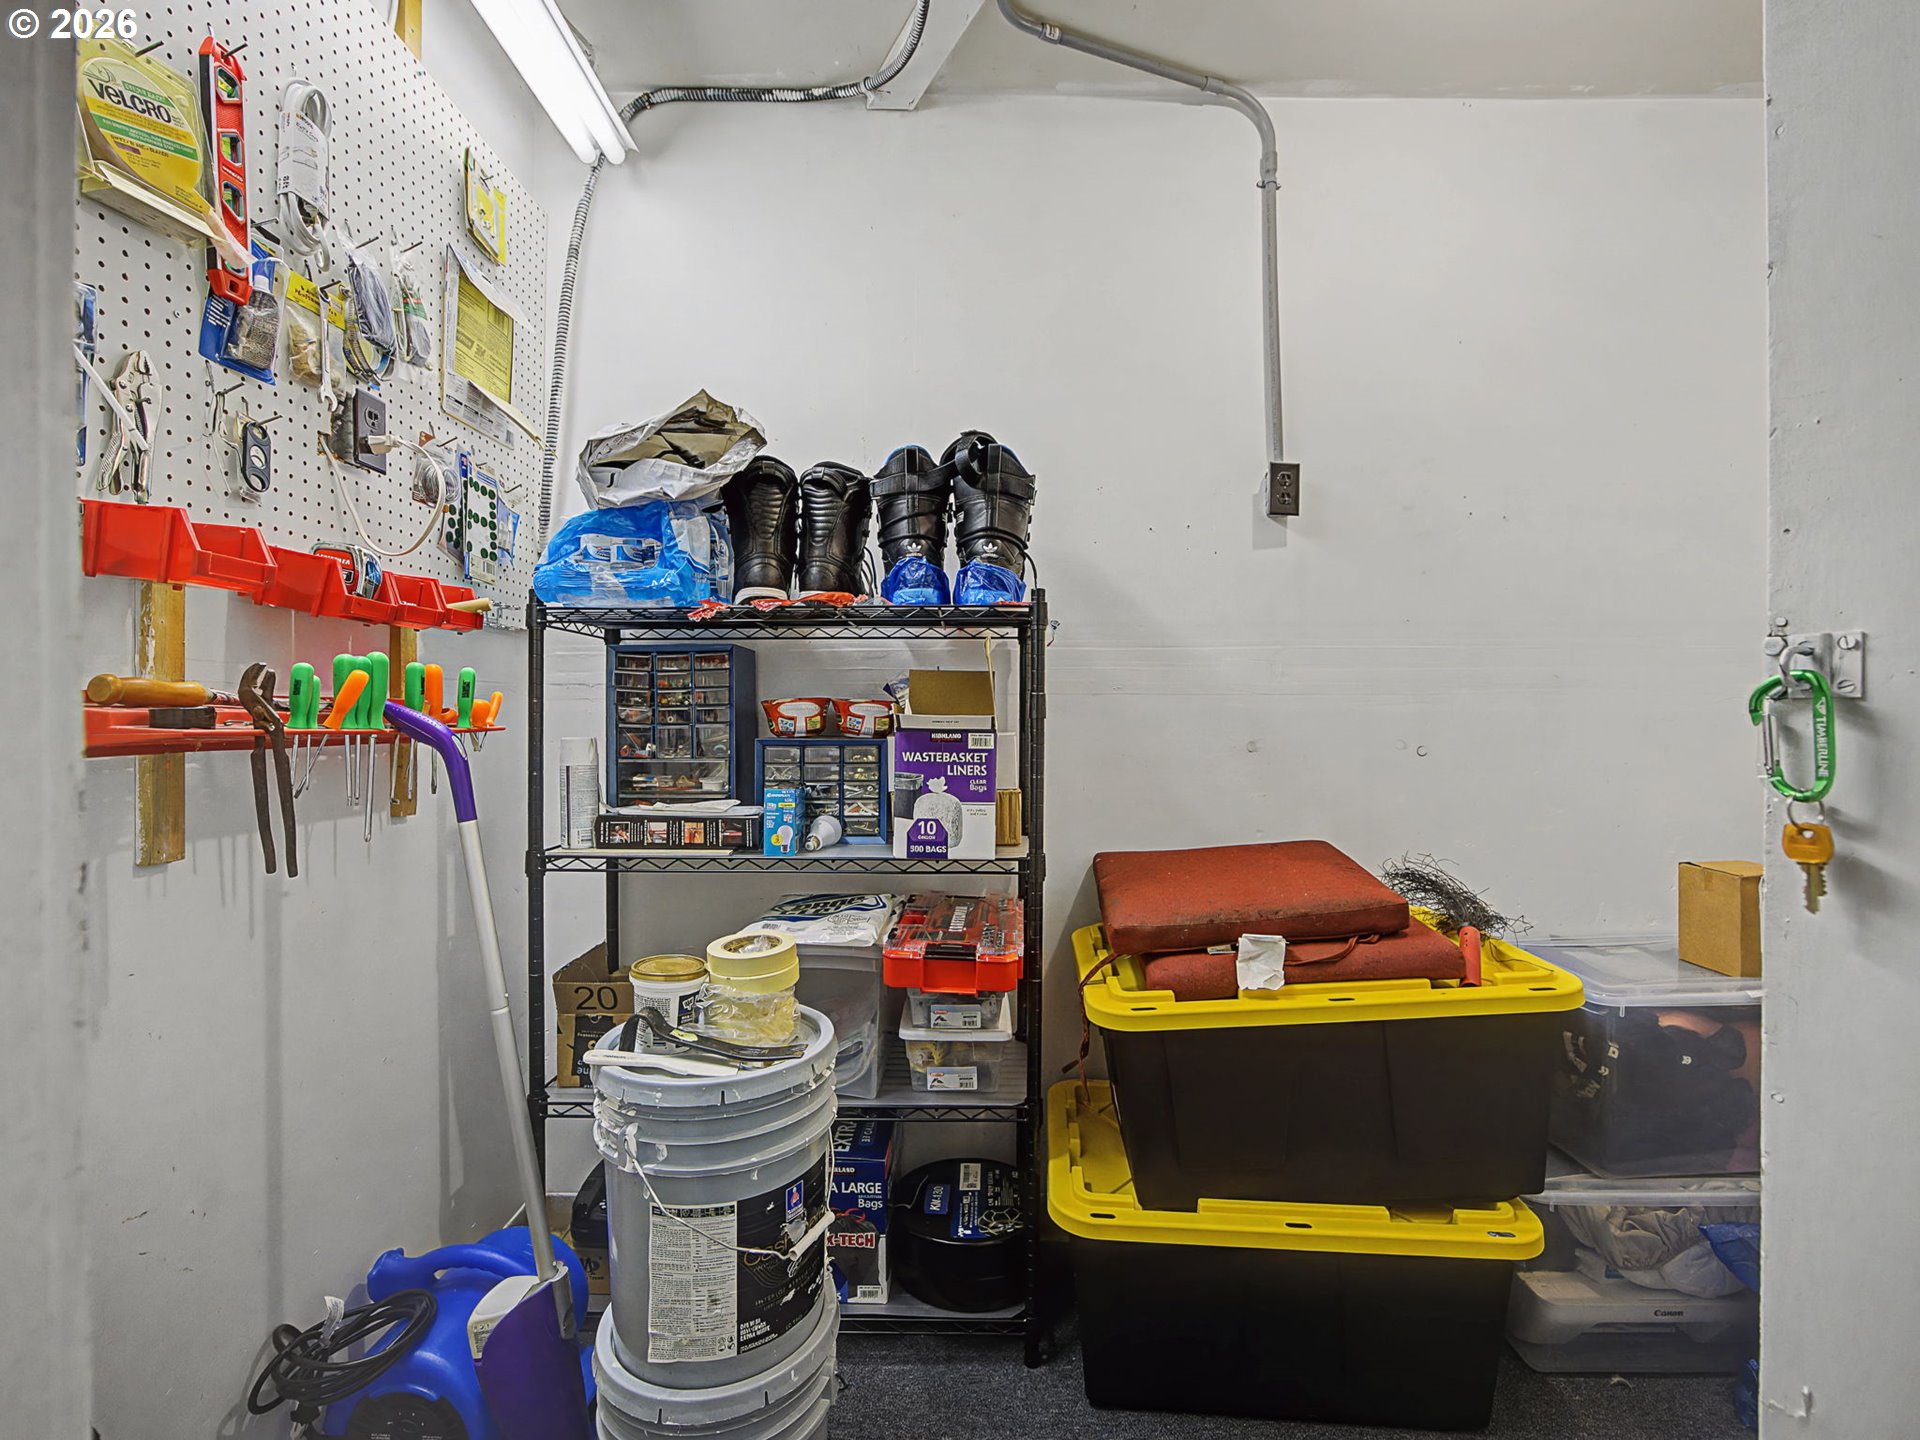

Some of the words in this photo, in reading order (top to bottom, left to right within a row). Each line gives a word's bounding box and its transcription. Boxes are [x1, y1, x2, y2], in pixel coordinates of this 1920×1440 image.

[1815, 716, 1829, 777] TIMBERLINE
[902, 752, 988, 763] WASTEBASKET
[947, 765, 987, 776] LINERS
[918, 820, 937, 835] 10
[925, 845, 947, 853] BAGS
[573, 986, 618, 1010] 20
[841, 1182, 882, 1194] LARGE
[858, 1199, 883, 1211] Bags
[1653, 1309, 1684, 1317] Canon
